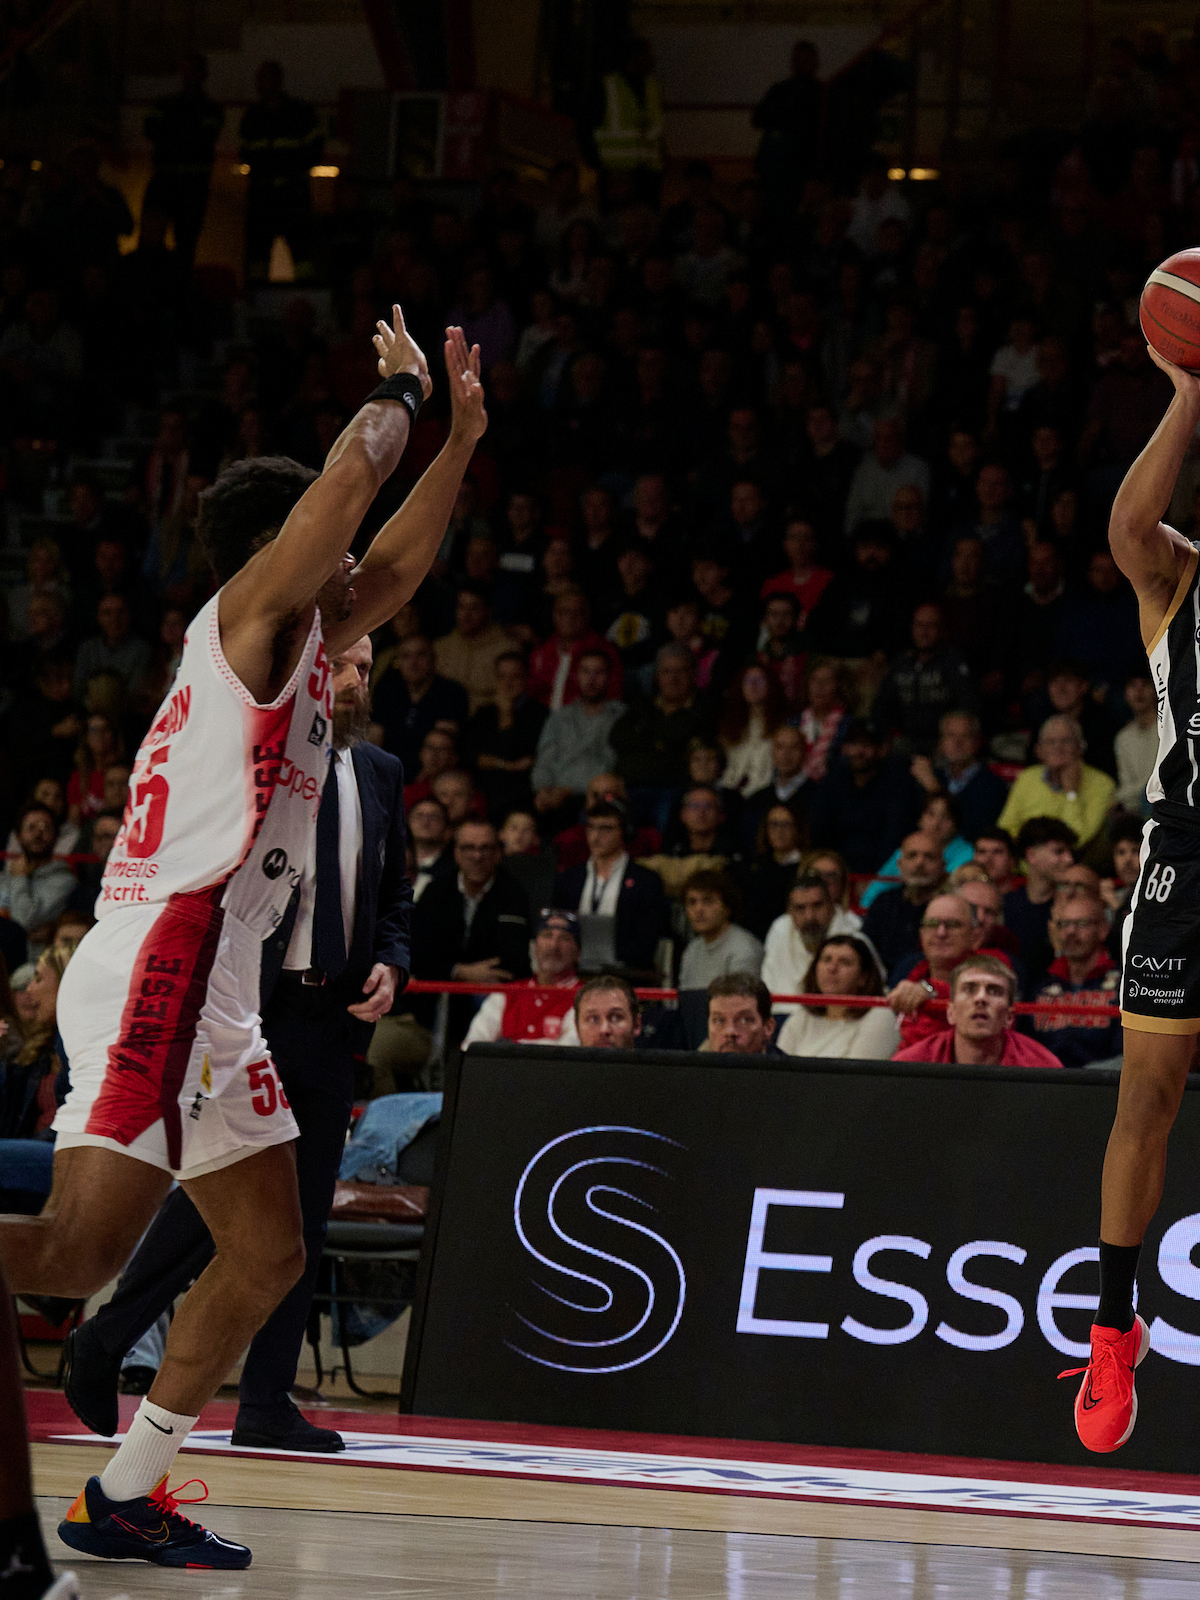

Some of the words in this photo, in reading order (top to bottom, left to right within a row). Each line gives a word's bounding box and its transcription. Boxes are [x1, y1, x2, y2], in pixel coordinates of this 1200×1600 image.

[1144, 863, 1176, 903] 68
[1131, 954, 1187, 971] CAVIT
[1140, 986, 1186, 998] Dolomiti
[1153, 998, 1184, 1006] energia
[117, 954, 182, 1075] VARESE
